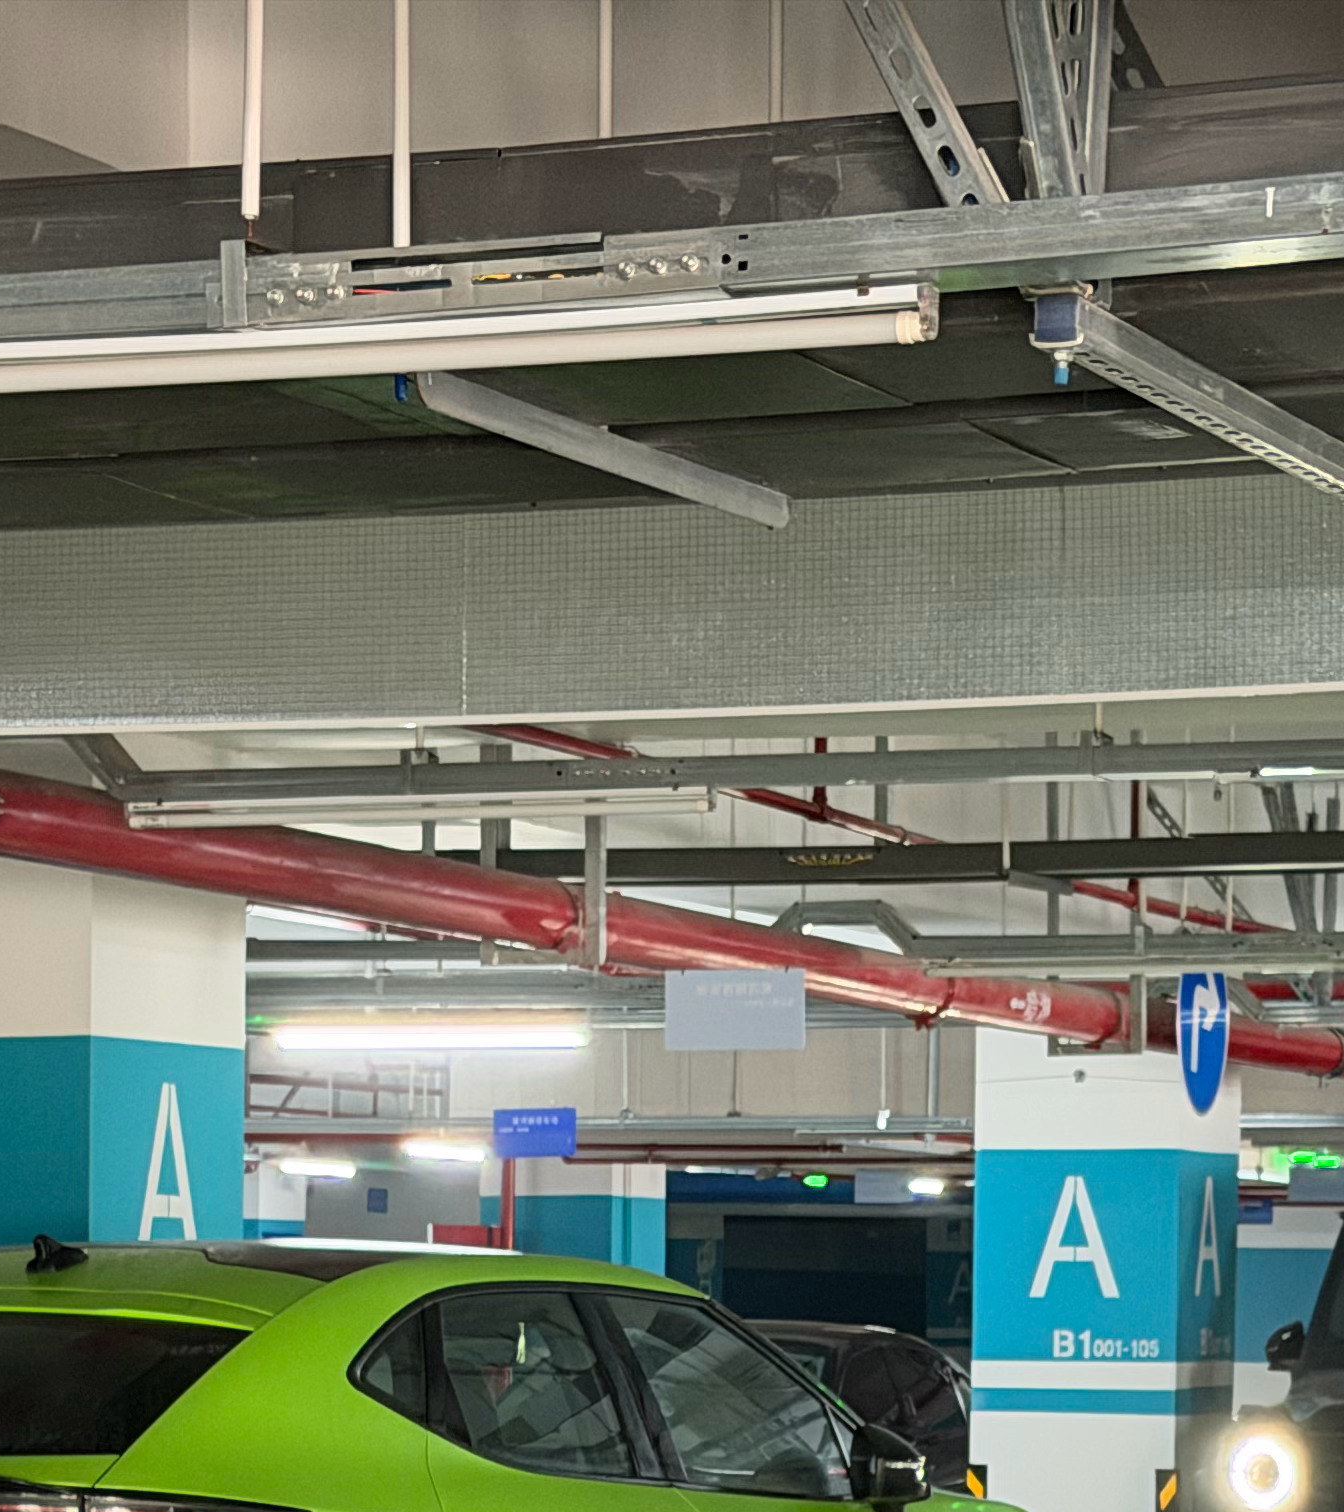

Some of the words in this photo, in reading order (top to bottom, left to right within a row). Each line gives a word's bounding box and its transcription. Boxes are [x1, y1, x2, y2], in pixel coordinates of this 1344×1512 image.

[138, 1082, 197, 1241] A
[1029, 1176, 1120, 1299] A
[1194, 1176, 1221, 1296] A
